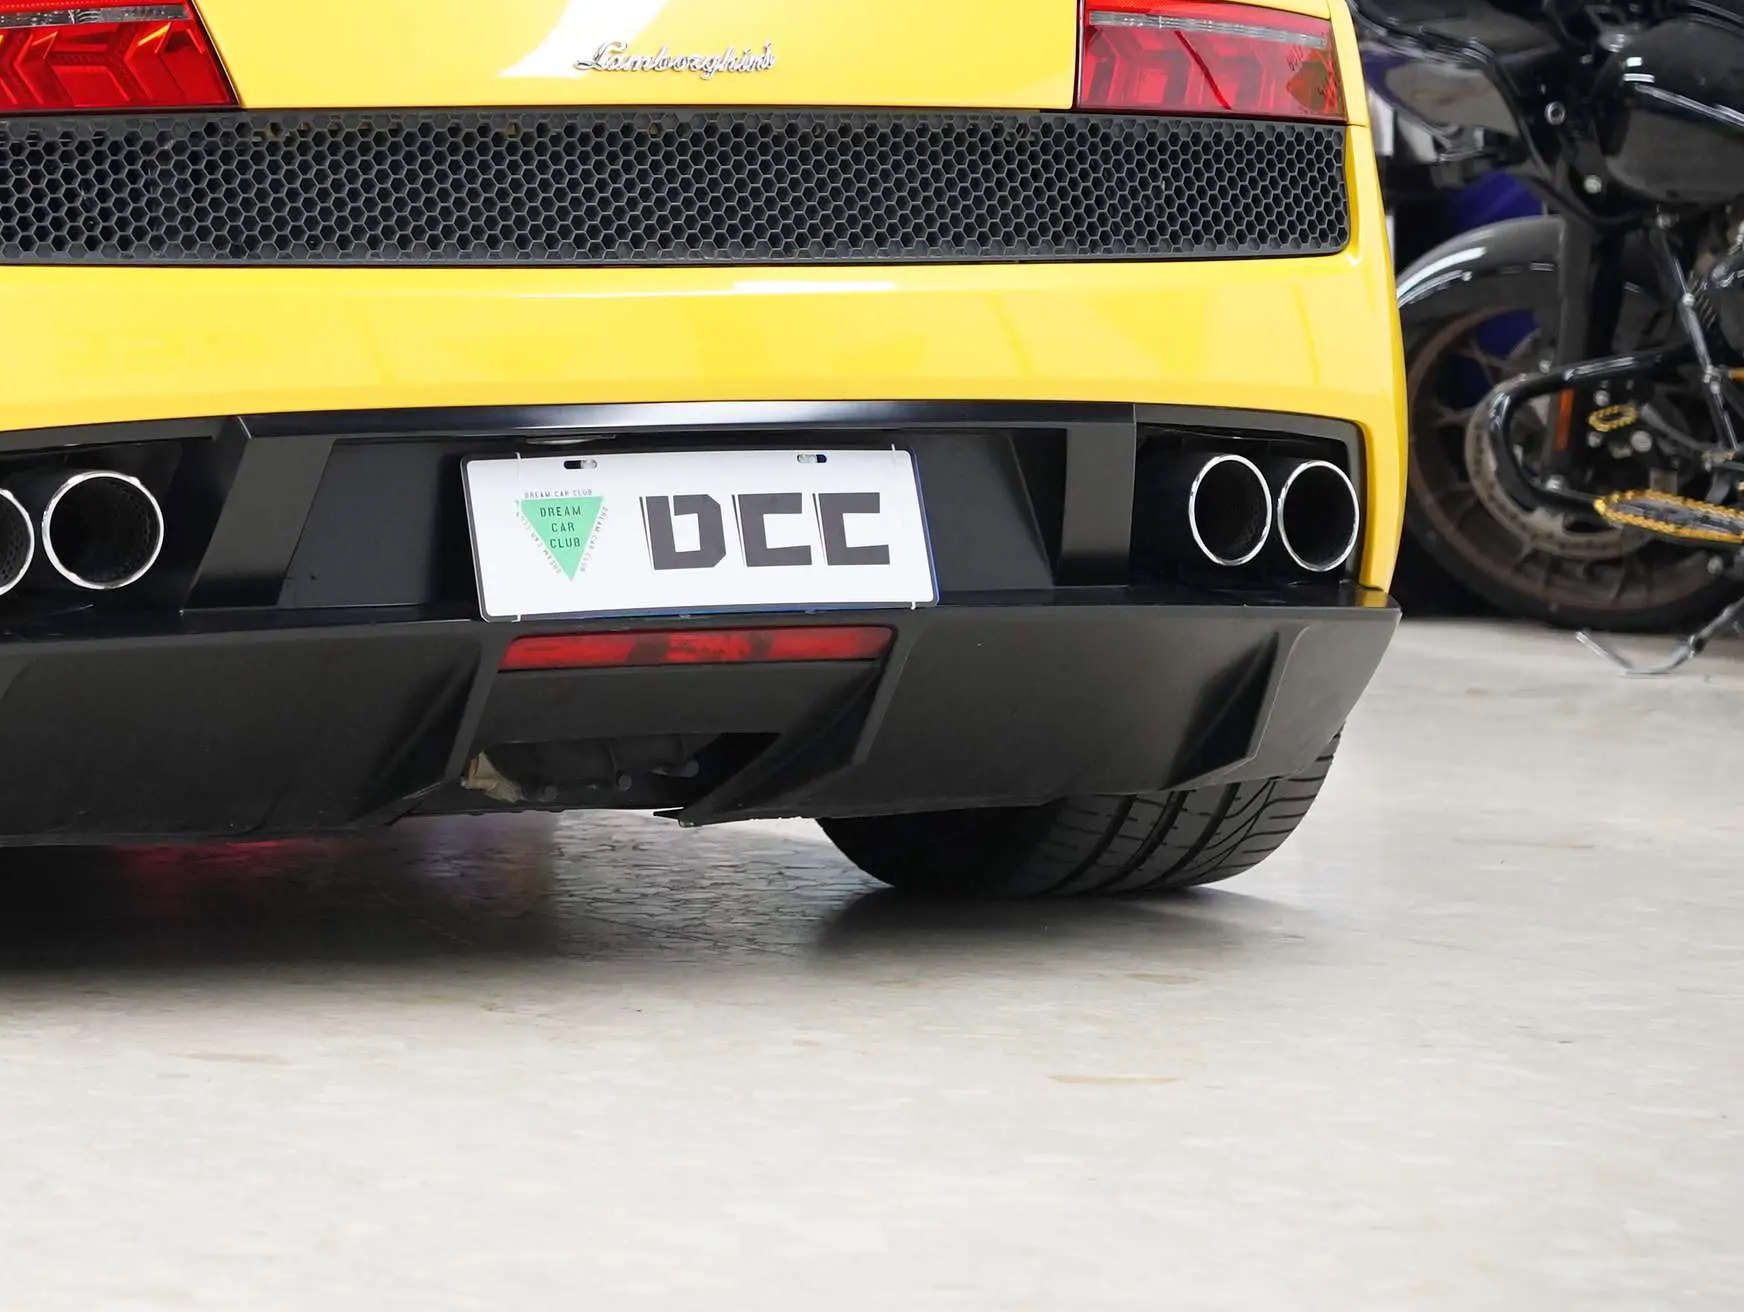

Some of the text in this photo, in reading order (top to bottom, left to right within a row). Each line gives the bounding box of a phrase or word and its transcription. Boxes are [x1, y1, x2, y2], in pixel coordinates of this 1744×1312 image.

[574, 40, 777, 80] Lamborghini
[539, 506, 582, 517] DREAM
[551, 522, 576, 533] CAR
[639, 491, 891, 571] DCC
[549, 537, 582, 549] CLUB
